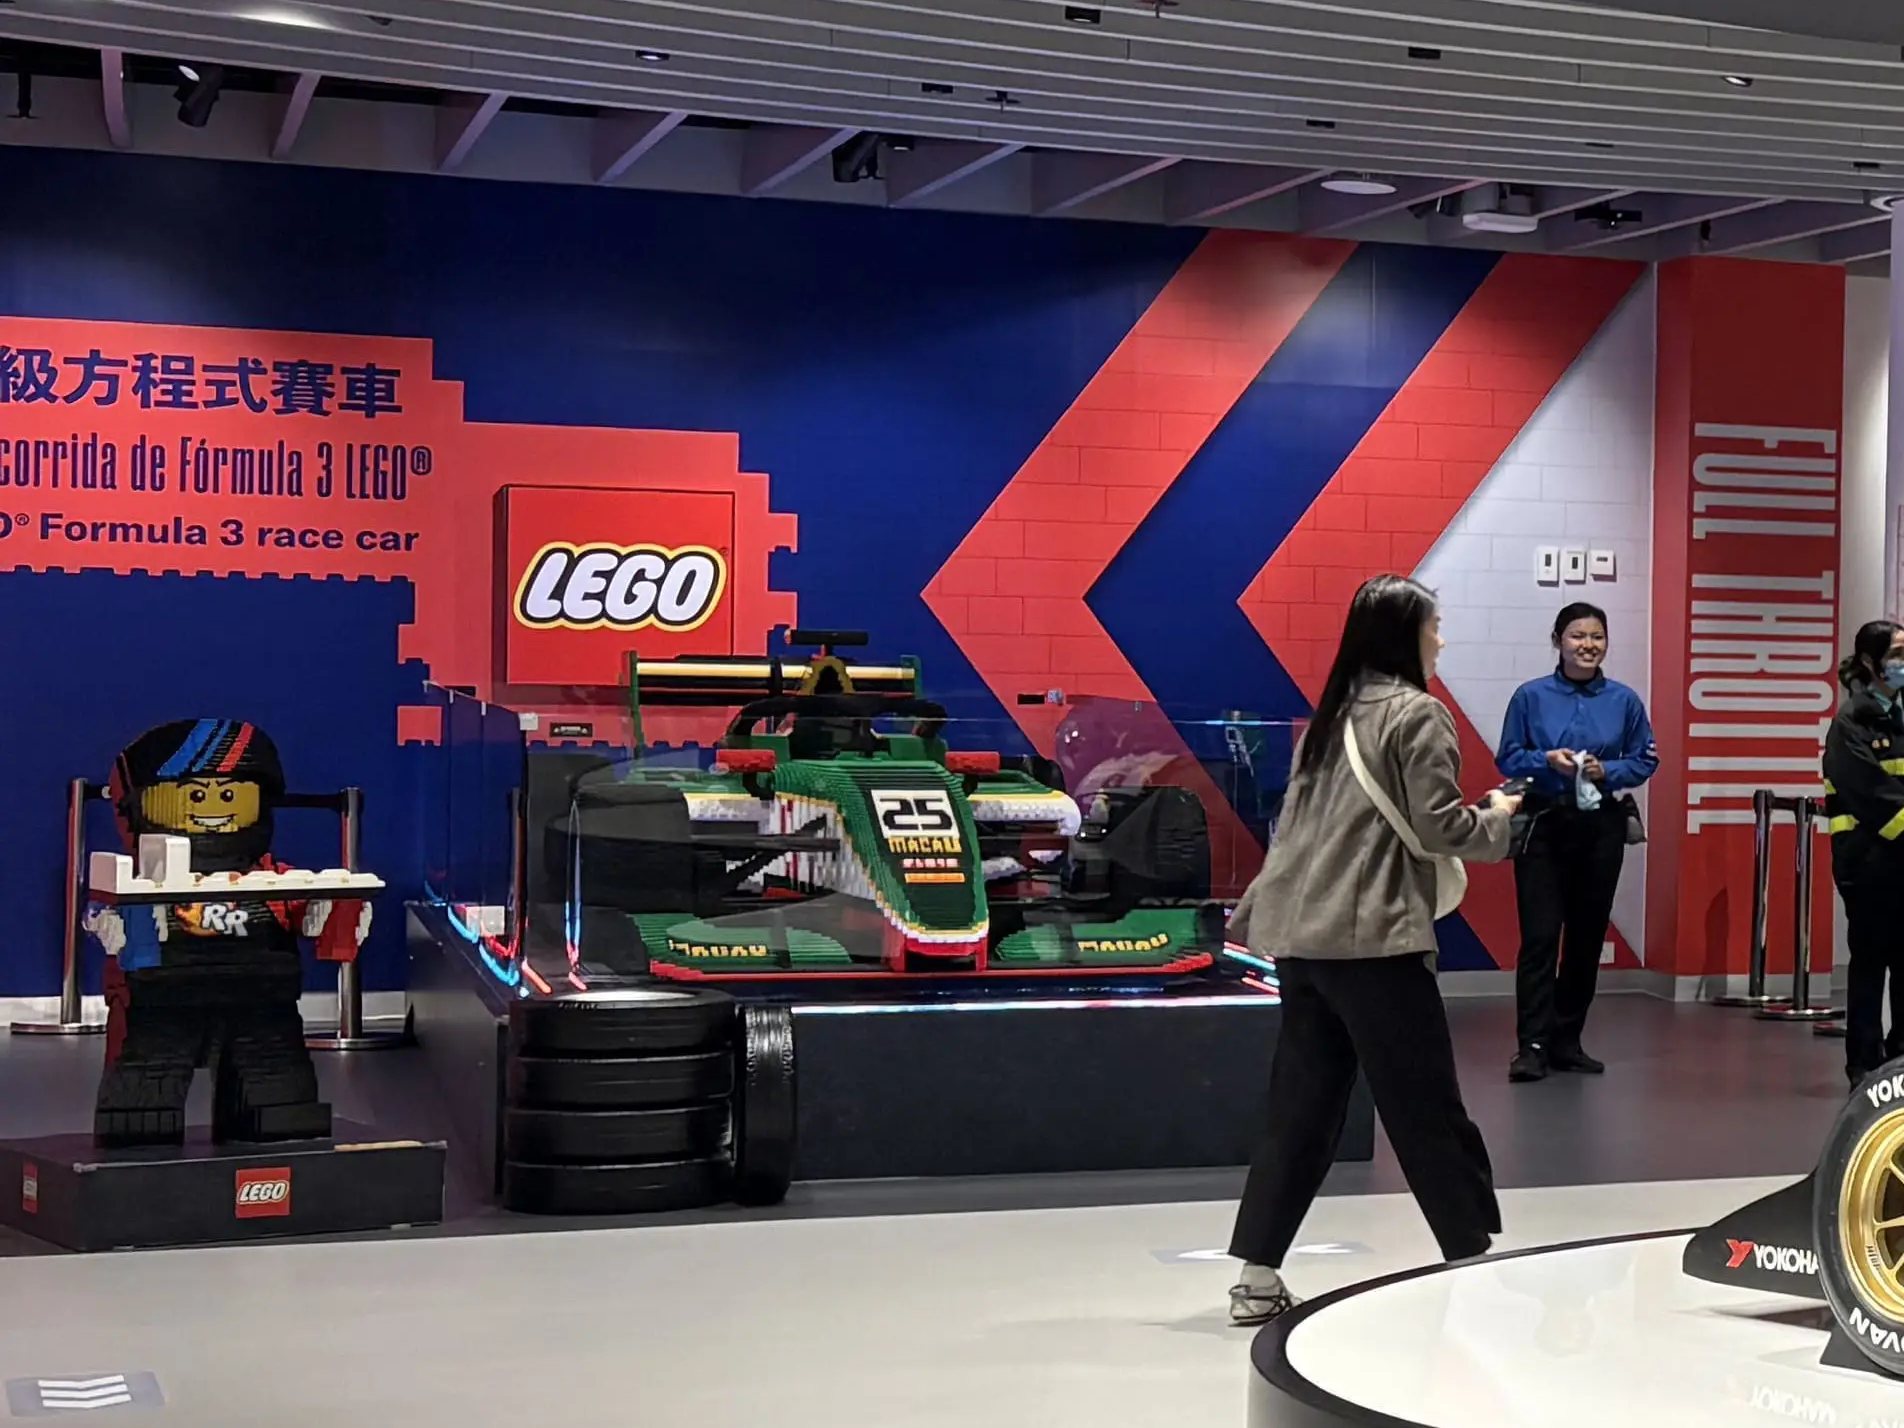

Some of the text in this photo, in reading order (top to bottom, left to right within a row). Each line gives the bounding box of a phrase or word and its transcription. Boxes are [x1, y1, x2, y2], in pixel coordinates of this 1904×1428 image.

[130, 436, 167, 492] de
[180, 437, 305, 498] Fórmula
[315, 442, 335, 498] 3
[1692, 423, 1838, 539] FULL
[39, 512, 420, 554] Formula 3 race car
[519, 546, 722, 627] LEGO
[1687, 571, 1837, 834] THROTTLE
[880, 798, 952, 830] 25
[237, 1179, 289, 1206] LEGO
